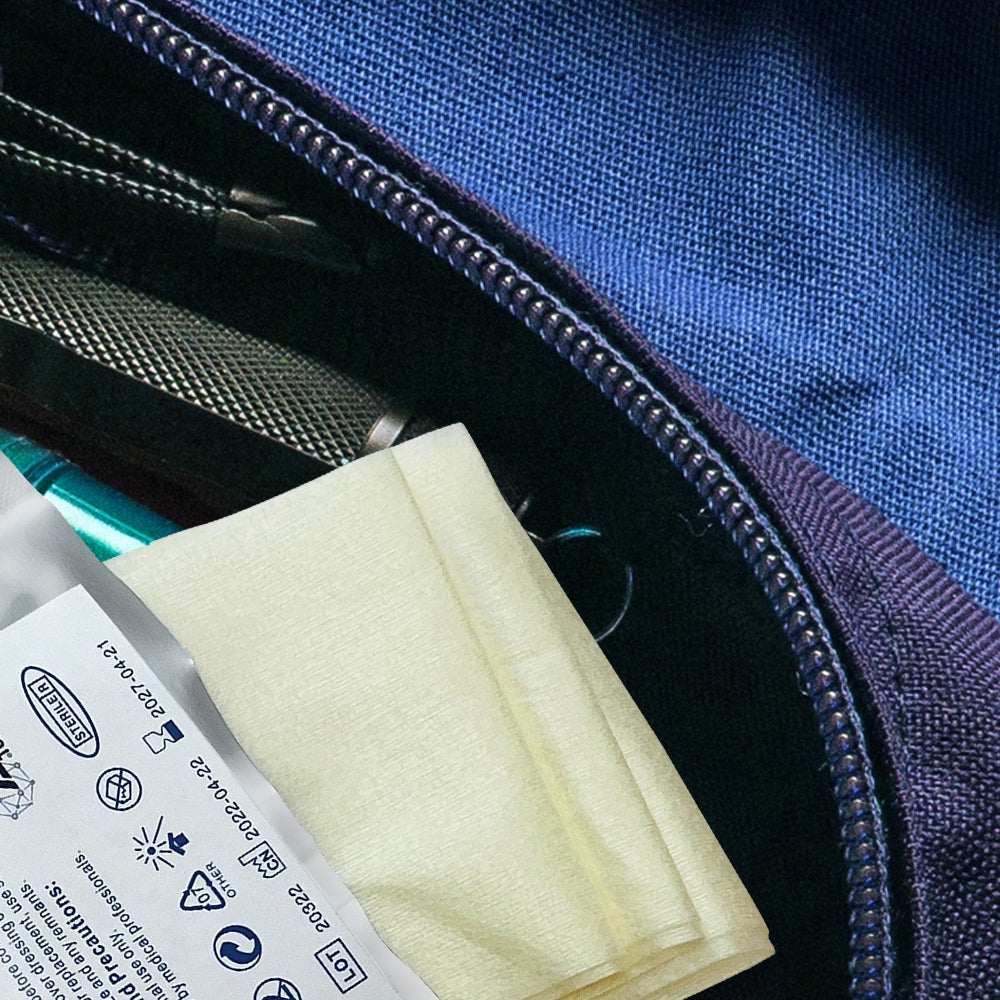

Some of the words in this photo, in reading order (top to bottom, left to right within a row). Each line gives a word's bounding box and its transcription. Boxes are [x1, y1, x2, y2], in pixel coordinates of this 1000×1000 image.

[36, 680, 50, 694] R
[95, 638, 166, 719] 2027-04-21
[44, 692, 87, 742] STERILE
[188, 754, 261, 841] 2022-04-22
[204, 859, 237, 899] OTHER
[257, 847, 280, 871] CN
[0, 888, 23, 915] use
[19, 878, 68, 942] remnants.
[73, 848, 143, 936] professionals.
[286, 882, 331, 933] 20322
[0, 919, 45, 976] dressing
[17, 910, 83, 993] replacement,
[43, 879, 127, 986] Precautions:
[60, 940, 86, 965] any
[107, 927, 135, 960] only.
[76, 963, 104, 990] and
[129, 958, 153, 984] use
[131, 933, 177, 984] medical
[323, 948, 357, 983] LOT
